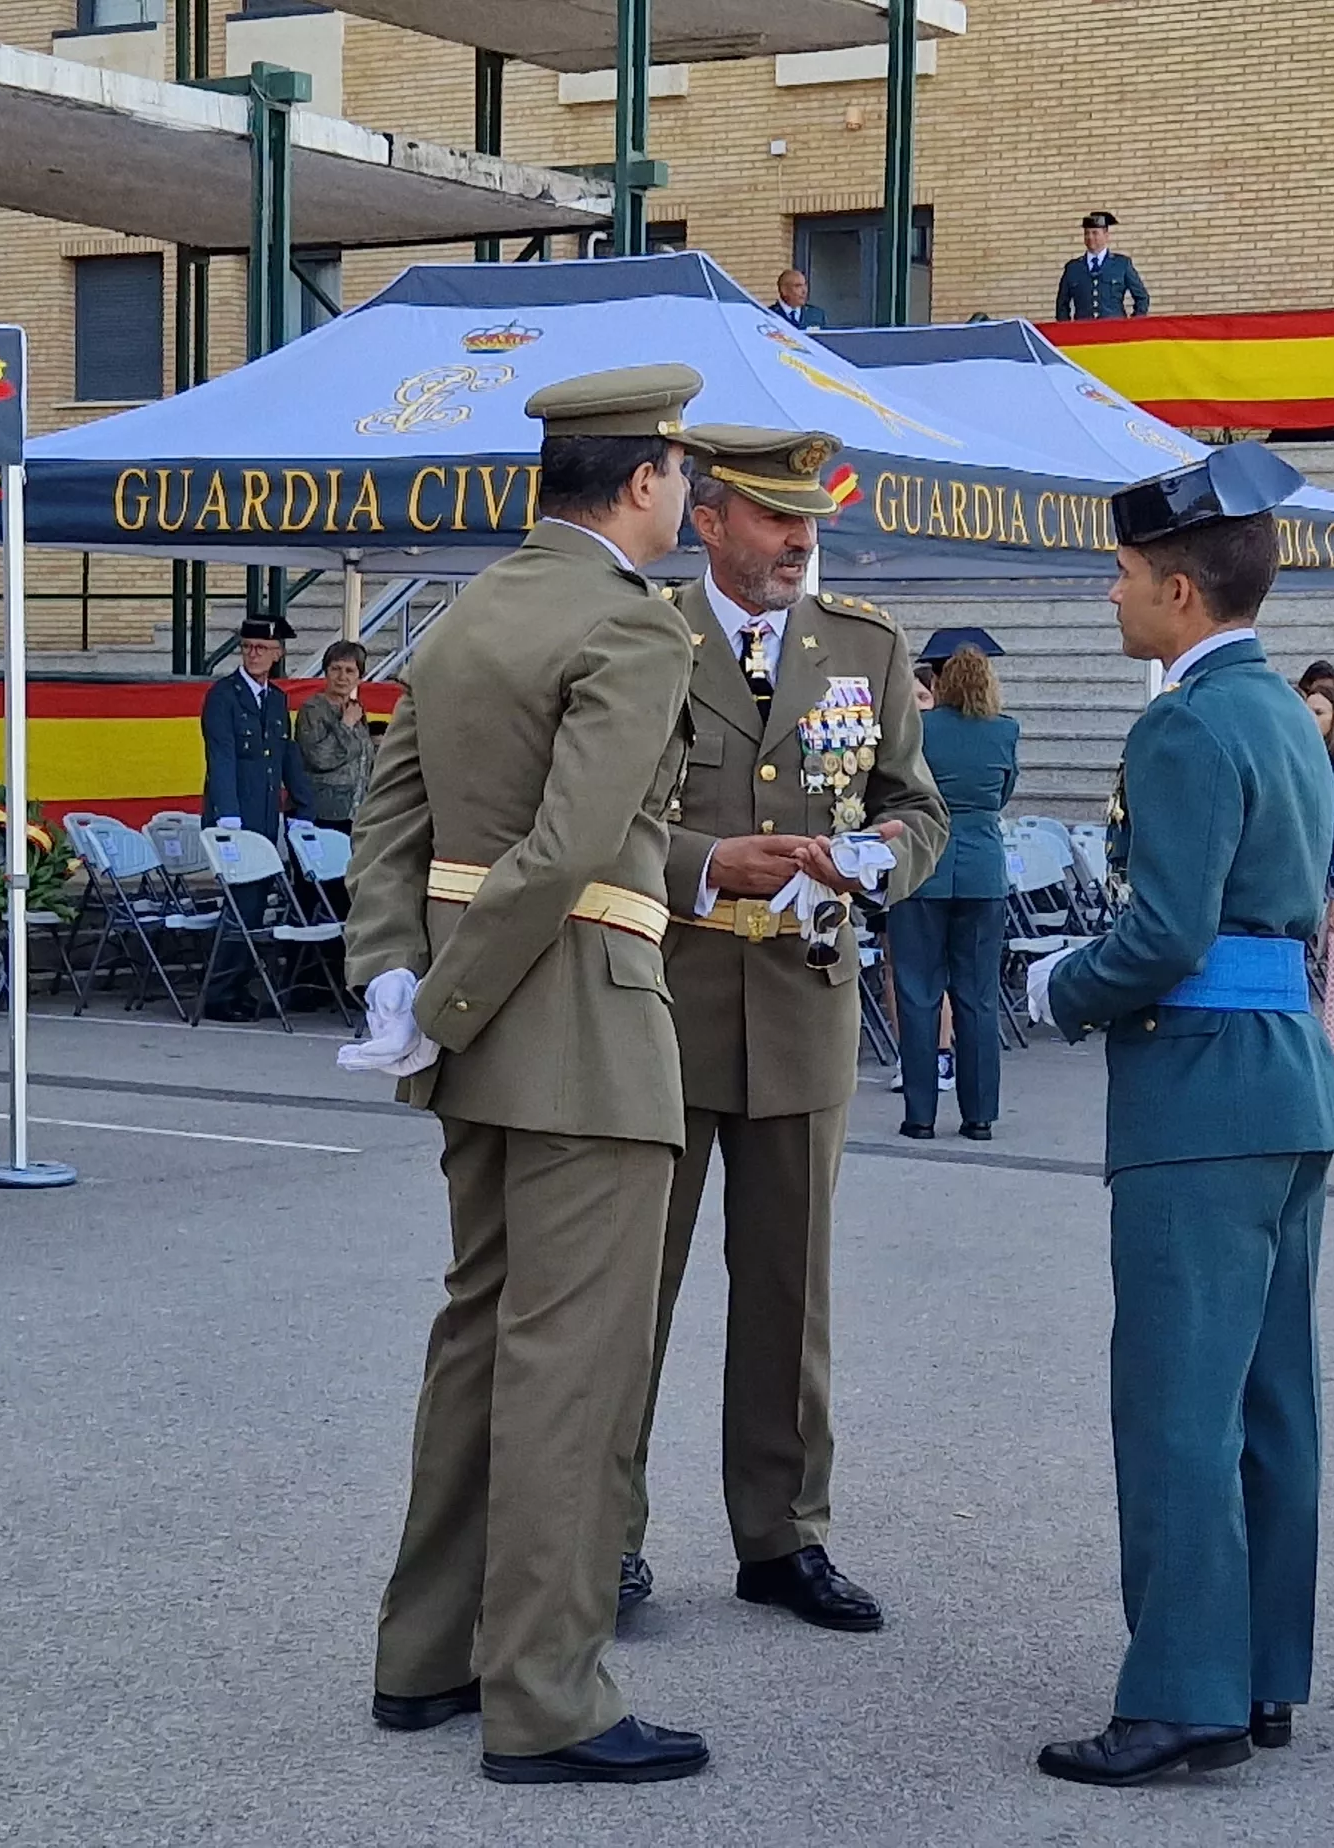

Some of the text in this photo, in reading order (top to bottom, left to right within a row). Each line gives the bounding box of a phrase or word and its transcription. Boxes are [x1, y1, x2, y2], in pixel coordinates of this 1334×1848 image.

[114, 465, 542, 532] GUARDIA CIVI
[874, 471, 1118, 551] GUARDIA CIVIL
